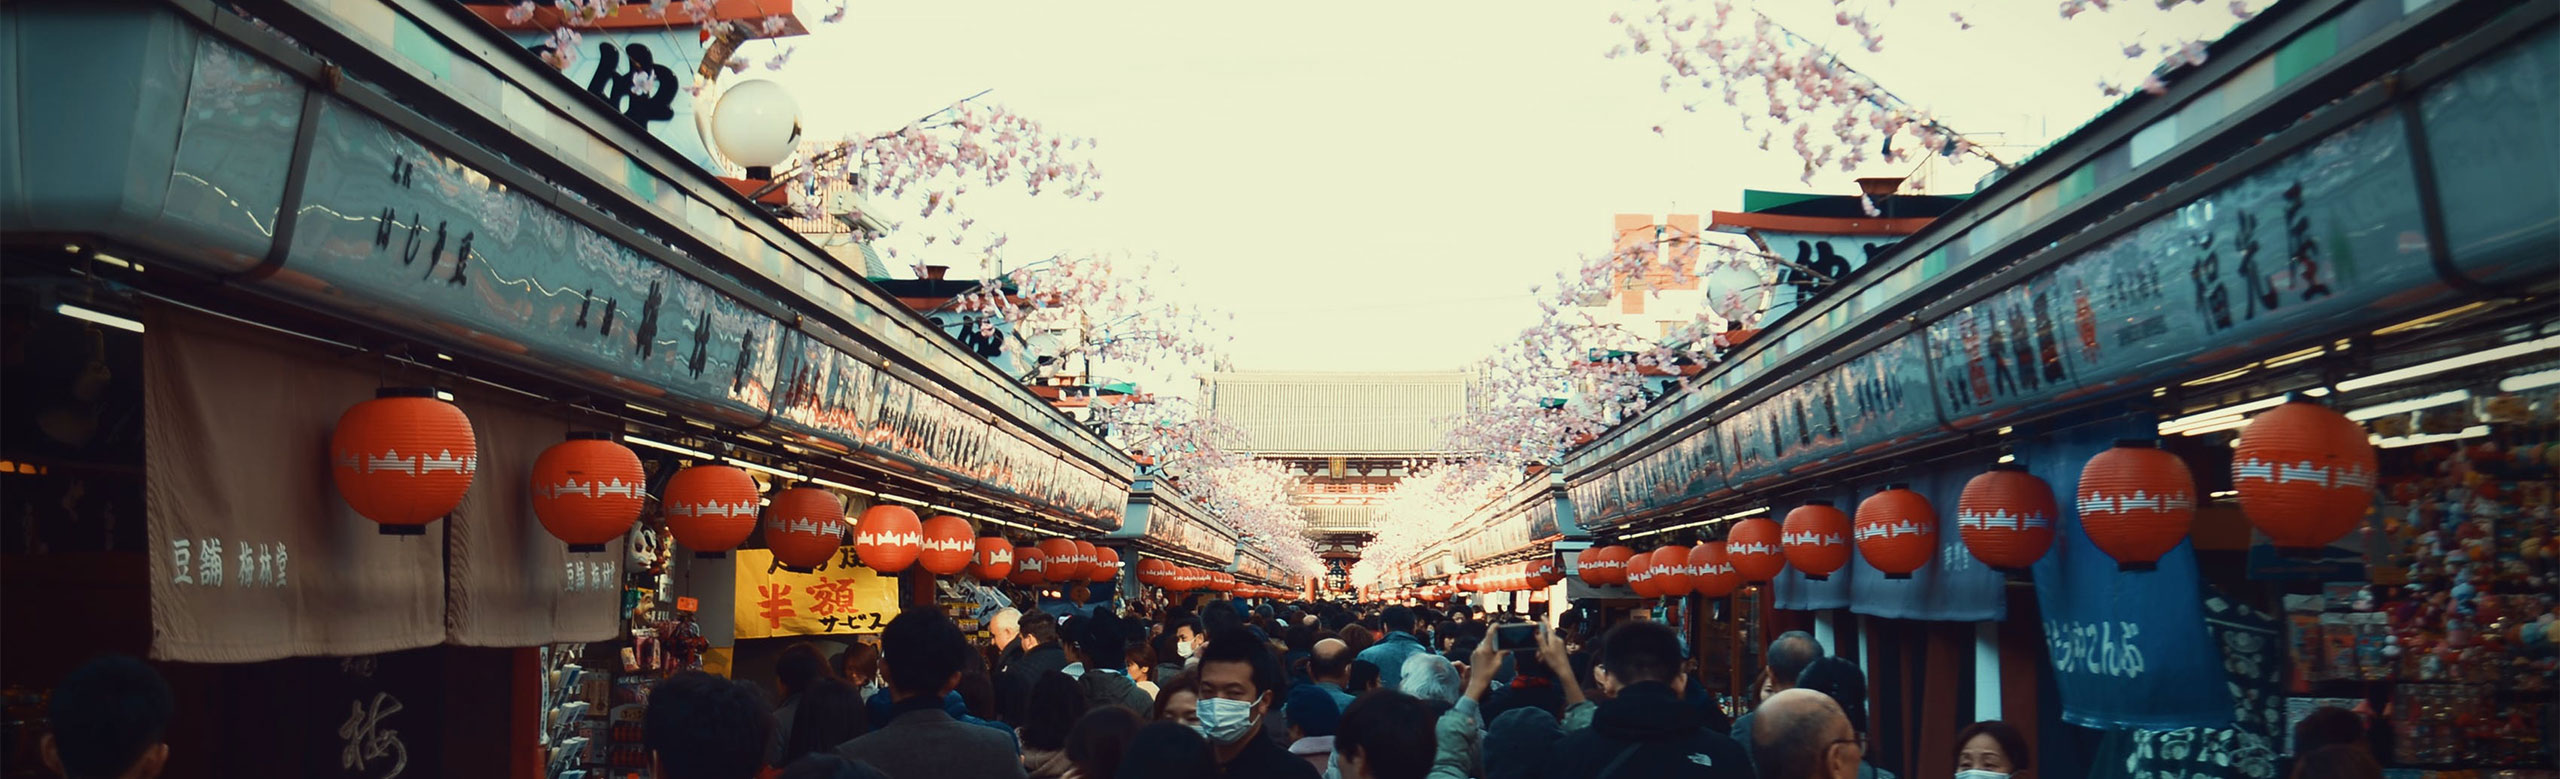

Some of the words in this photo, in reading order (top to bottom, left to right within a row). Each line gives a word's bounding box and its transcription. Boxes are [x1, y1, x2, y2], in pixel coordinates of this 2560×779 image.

[2190, 182, 2331, 335] 福光屋
[238, 541, 288, 588] 梅林堂
[757, 577, 858, 629] 半額
[819, 612, 888, 633] サービス
